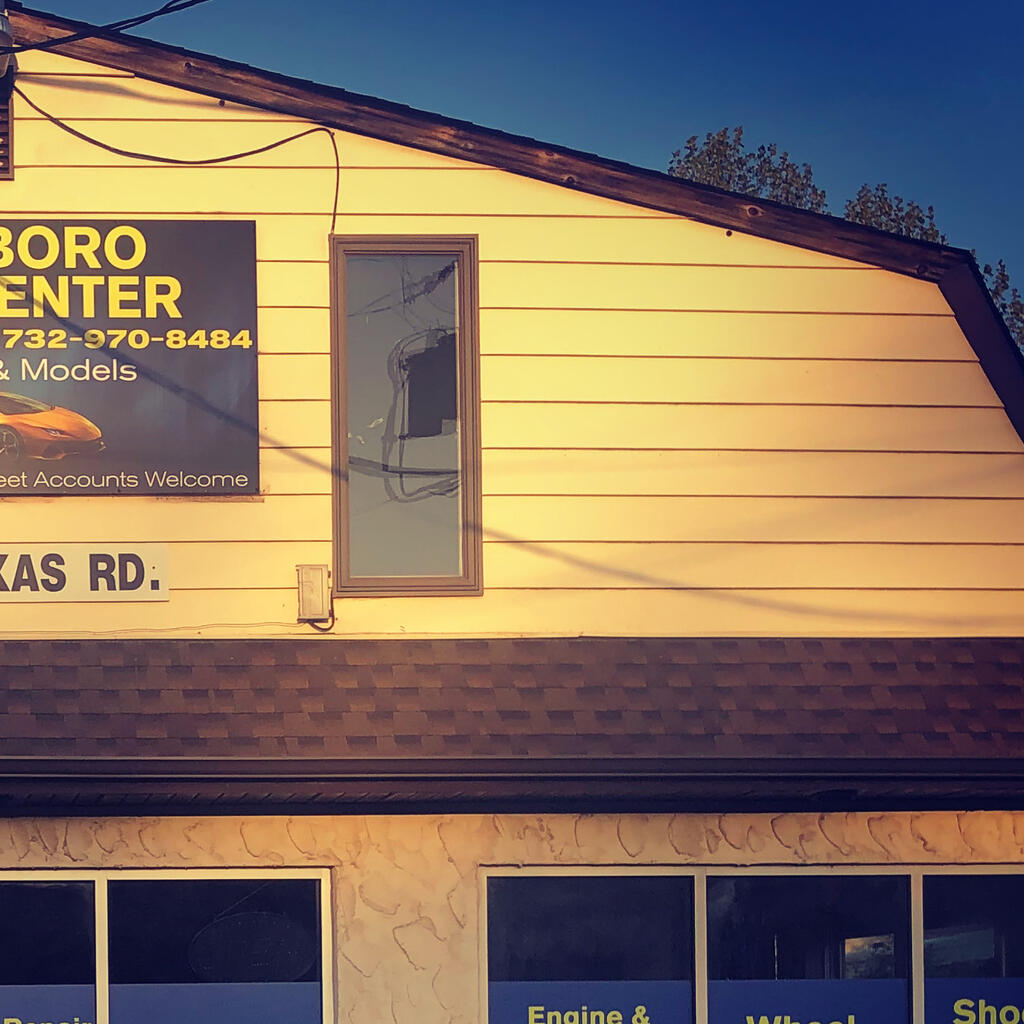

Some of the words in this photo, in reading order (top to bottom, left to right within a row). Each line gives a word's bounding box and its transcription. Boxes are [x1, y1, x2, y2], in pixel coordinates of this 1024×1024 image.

[2, 328, 253, 349] 732-970-8484
[21, 358, 138, 382] Models
[33, 471, 139, 488] Accounts
[144, 471, 249, 488] Welcome
[88, 553, 160, 592] RD.
